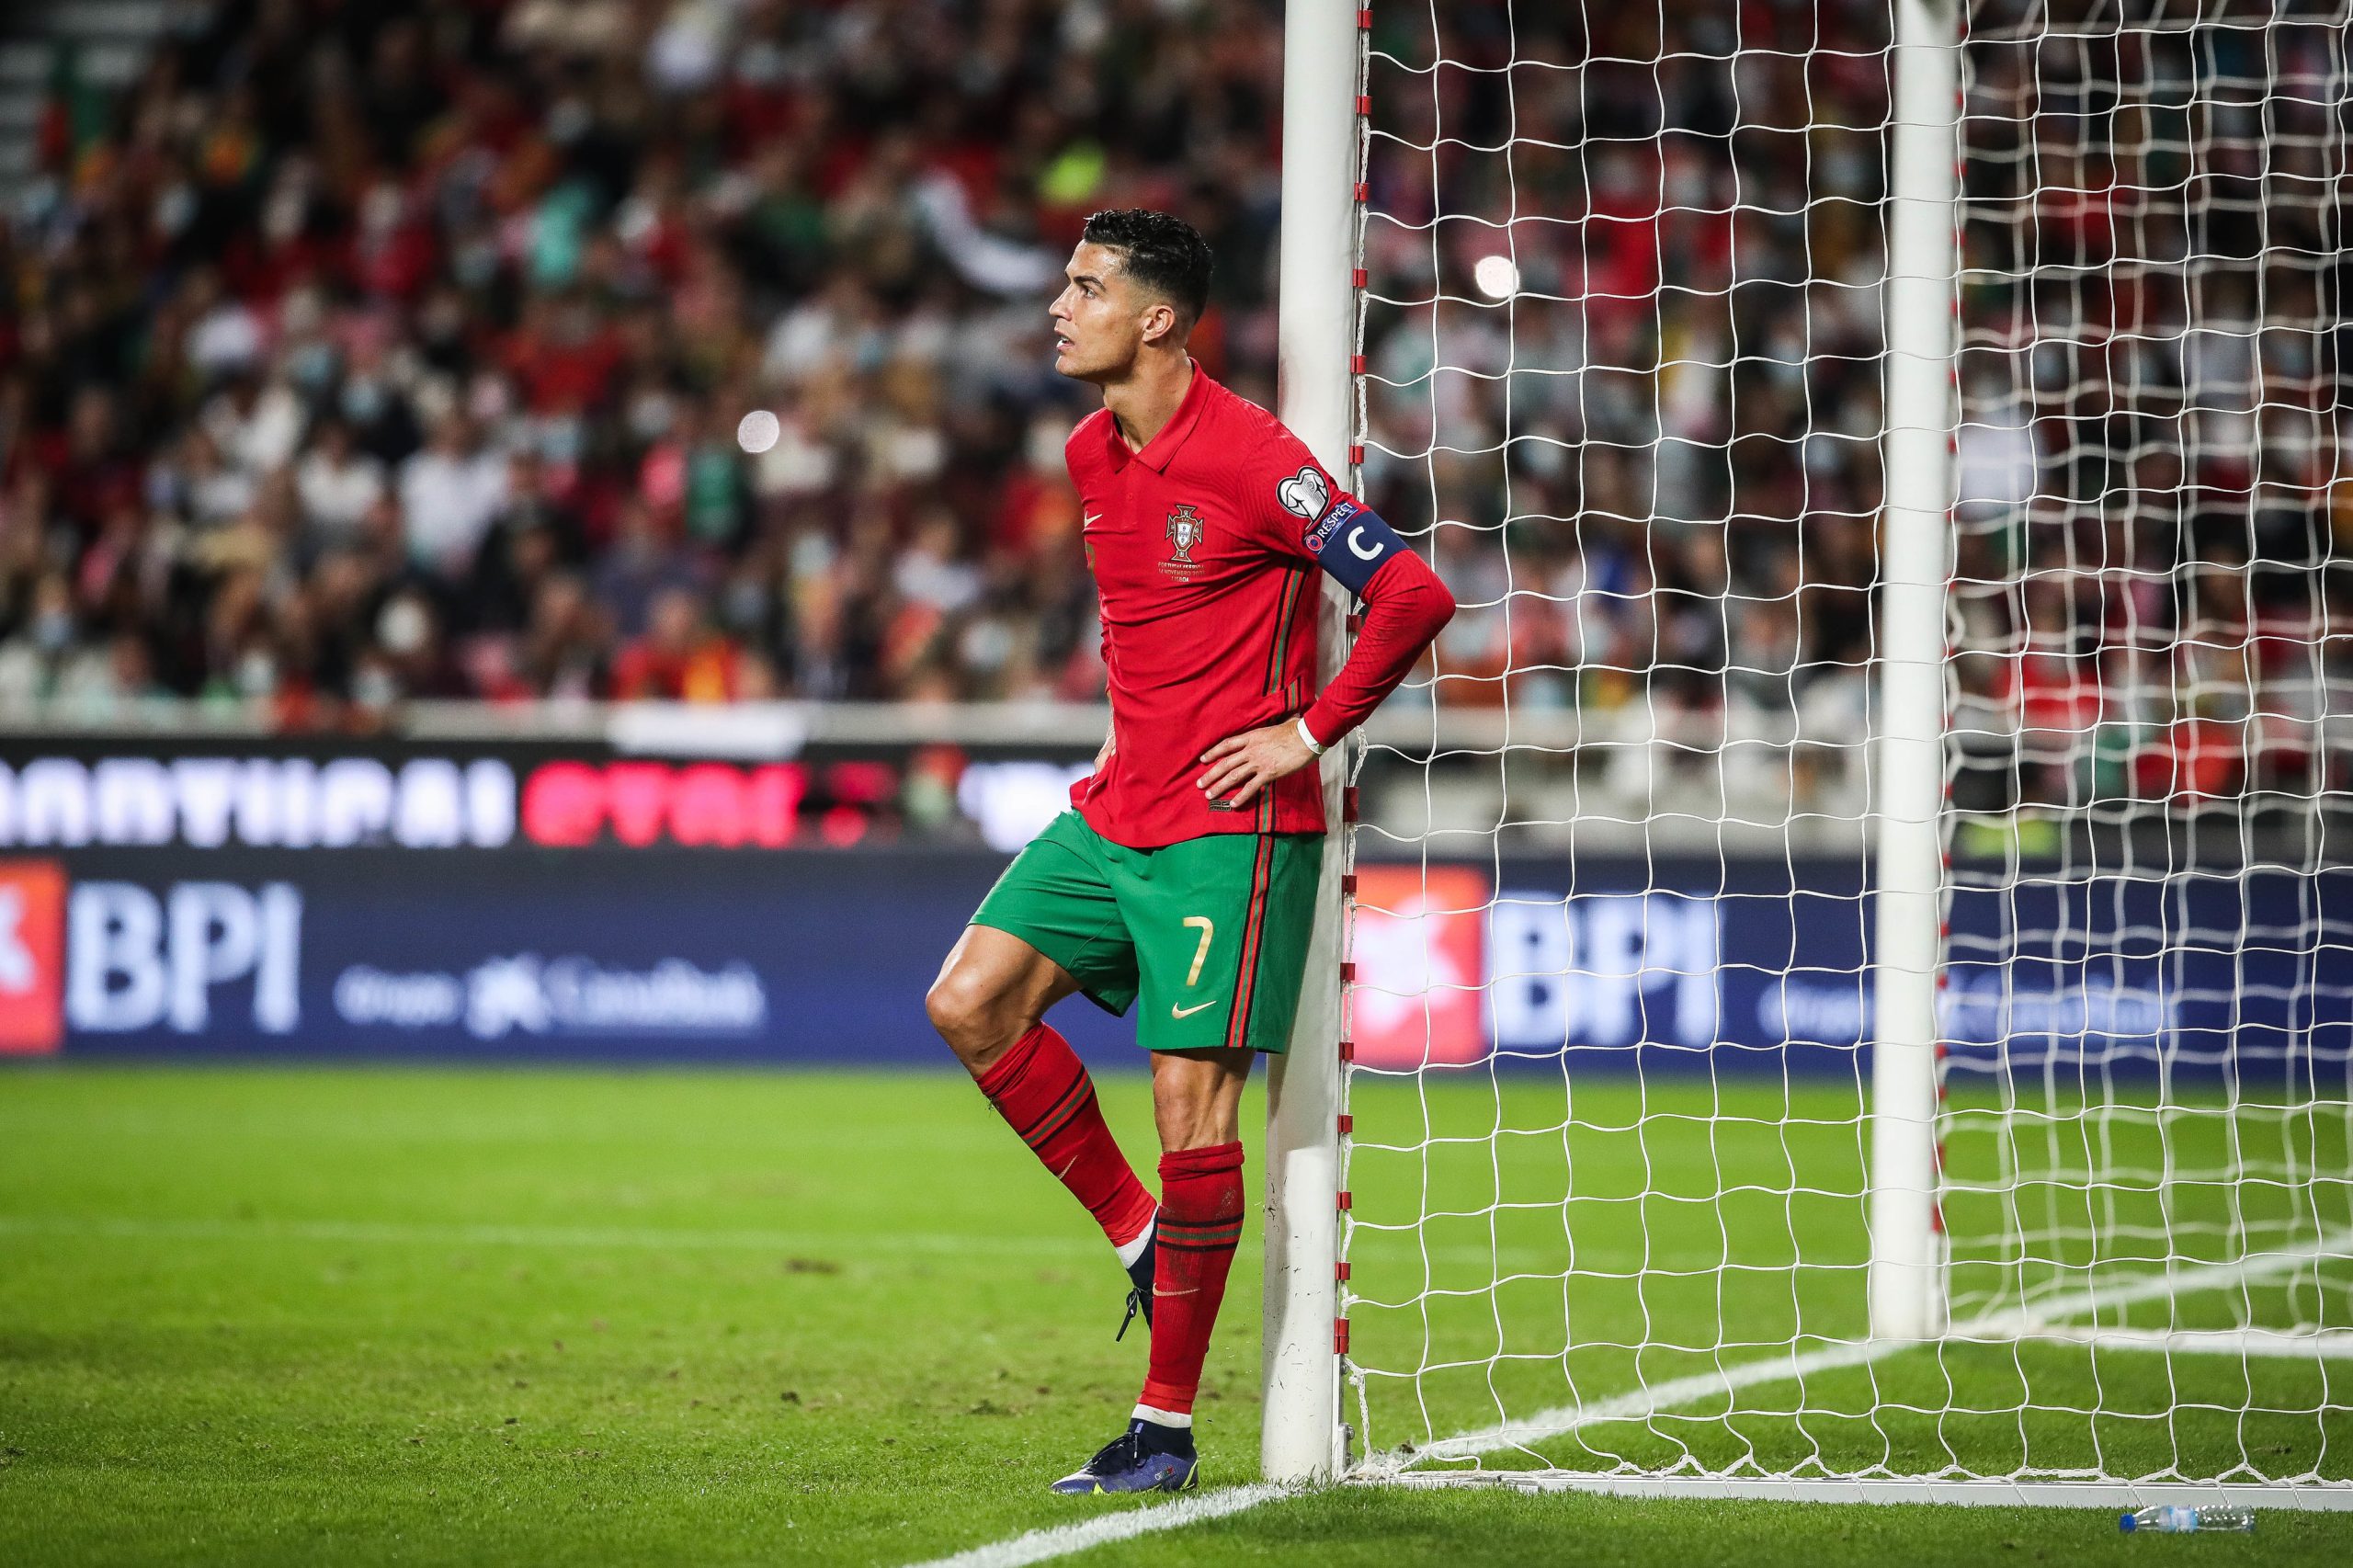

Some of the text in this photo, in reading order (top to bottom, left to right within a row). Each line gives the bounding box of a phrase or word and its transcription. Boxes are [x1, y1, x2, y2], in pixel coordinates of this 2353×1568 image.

[1317, 503, 1353, 539] RESPECT
[1347, 526, 1384, 561] C
[68, 880, 303, 1033] BPI
[1183, 915, 1214, 986] 7
[1483, 890, 1725, 1047] BPI
